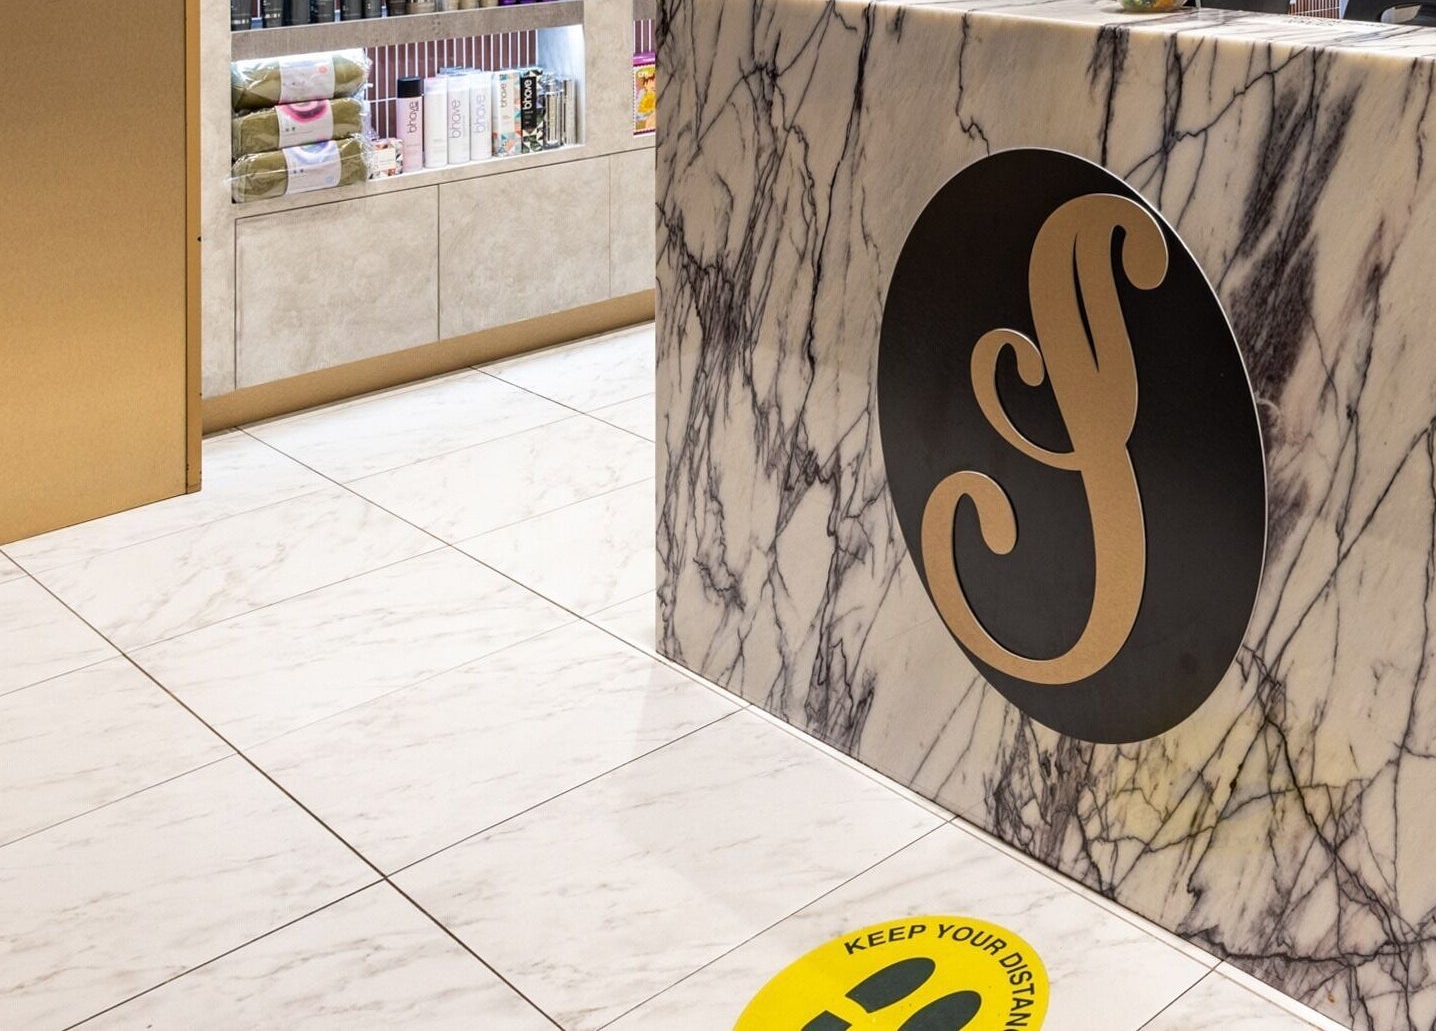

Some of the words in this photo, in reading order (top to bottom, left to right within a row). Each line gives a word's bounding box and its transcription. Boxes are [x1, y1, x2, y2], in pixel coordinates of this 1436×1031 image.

[500, 83, 508, 108] bhave
[522, 79, 533, 110] bhave
[408, 100, 420, 134] bhave
[450, 99, 462, 139] bhave
[473, 94, 486, 135] bhave
[844, 924, 927, 955] KEEP
[937, 923, 1008, 956] YOUR
[999, 952, 1036, 1031] DISTAN
